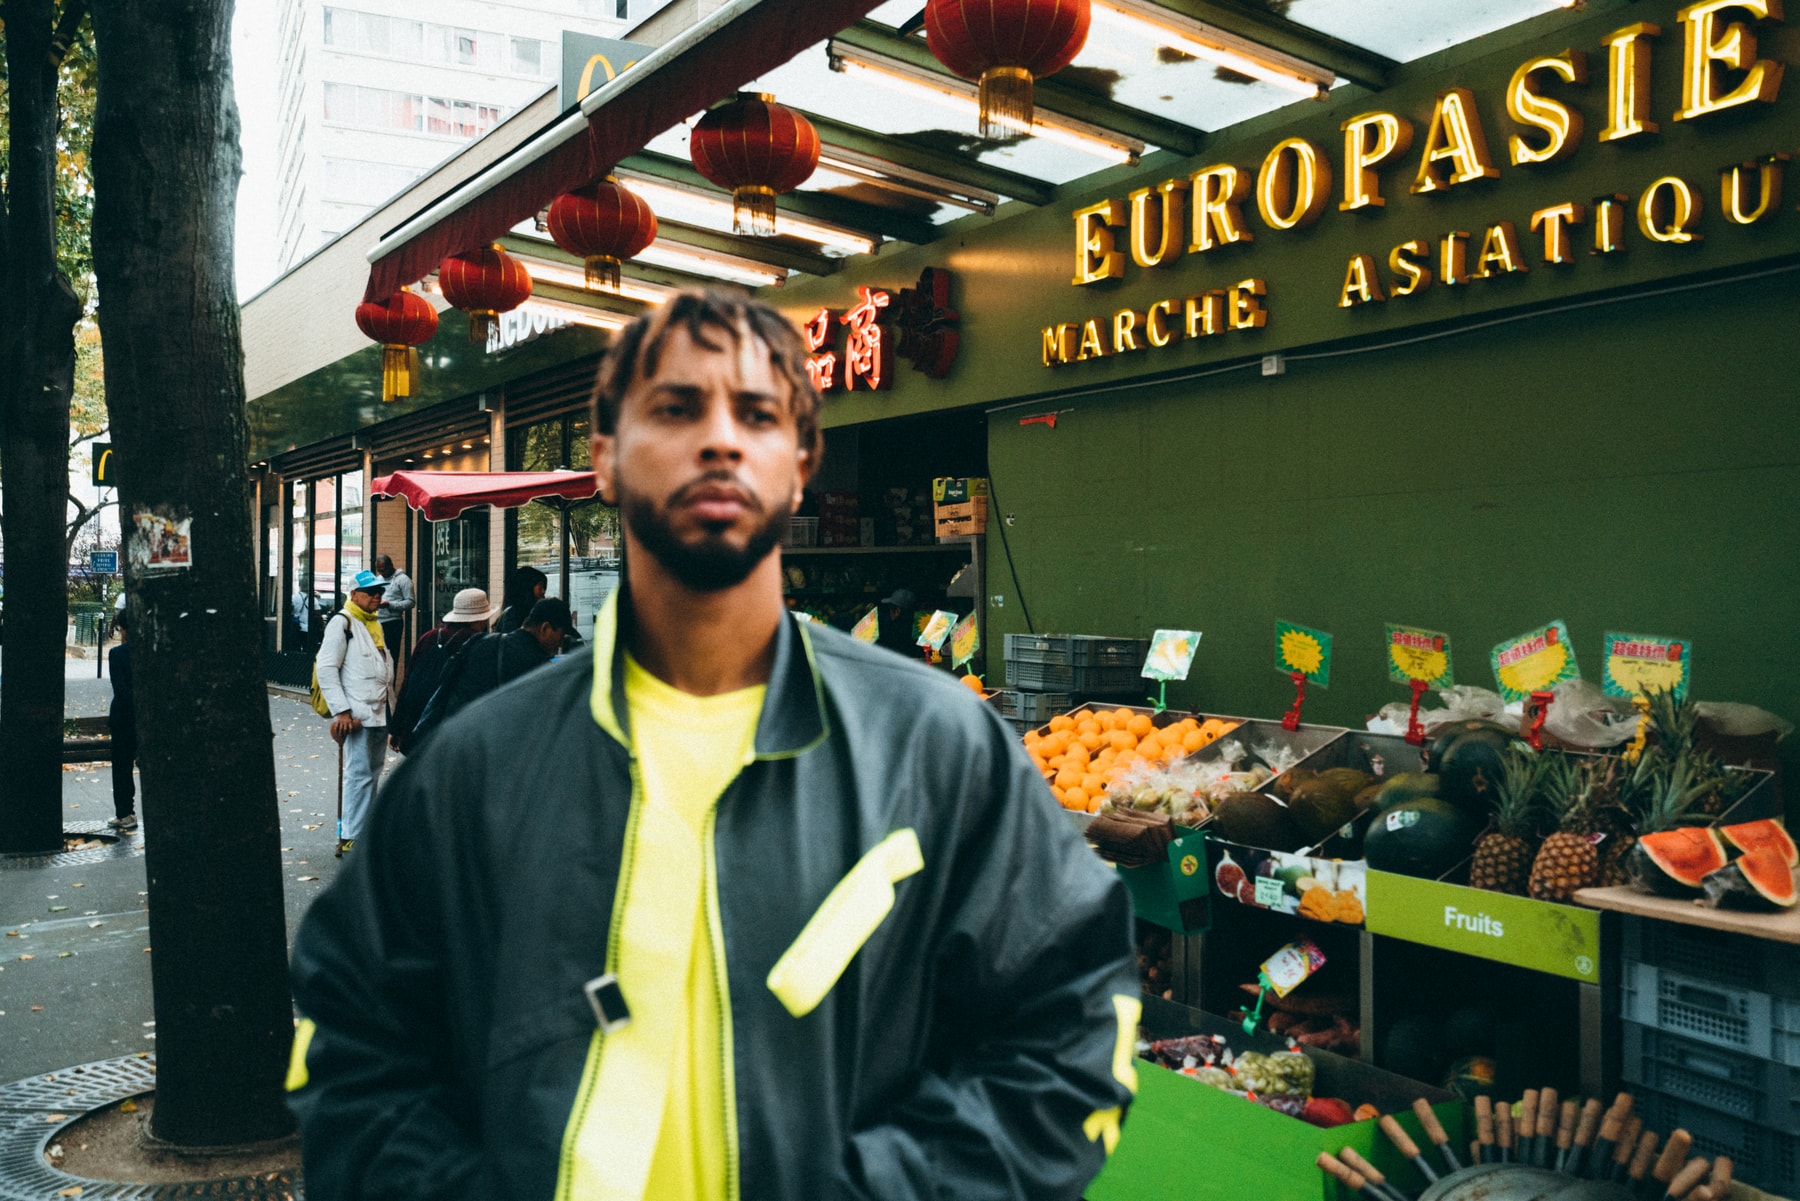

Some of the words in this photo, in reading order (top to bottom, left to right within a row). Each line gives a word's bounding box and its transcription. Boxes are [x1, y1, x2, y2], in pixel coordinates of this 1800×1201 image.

[1071, 0, 1786, 287] EUROPASIE
[1041, 278, 1268, 367] MARCHE
[1444, 906, 1504, 938] Fruits
